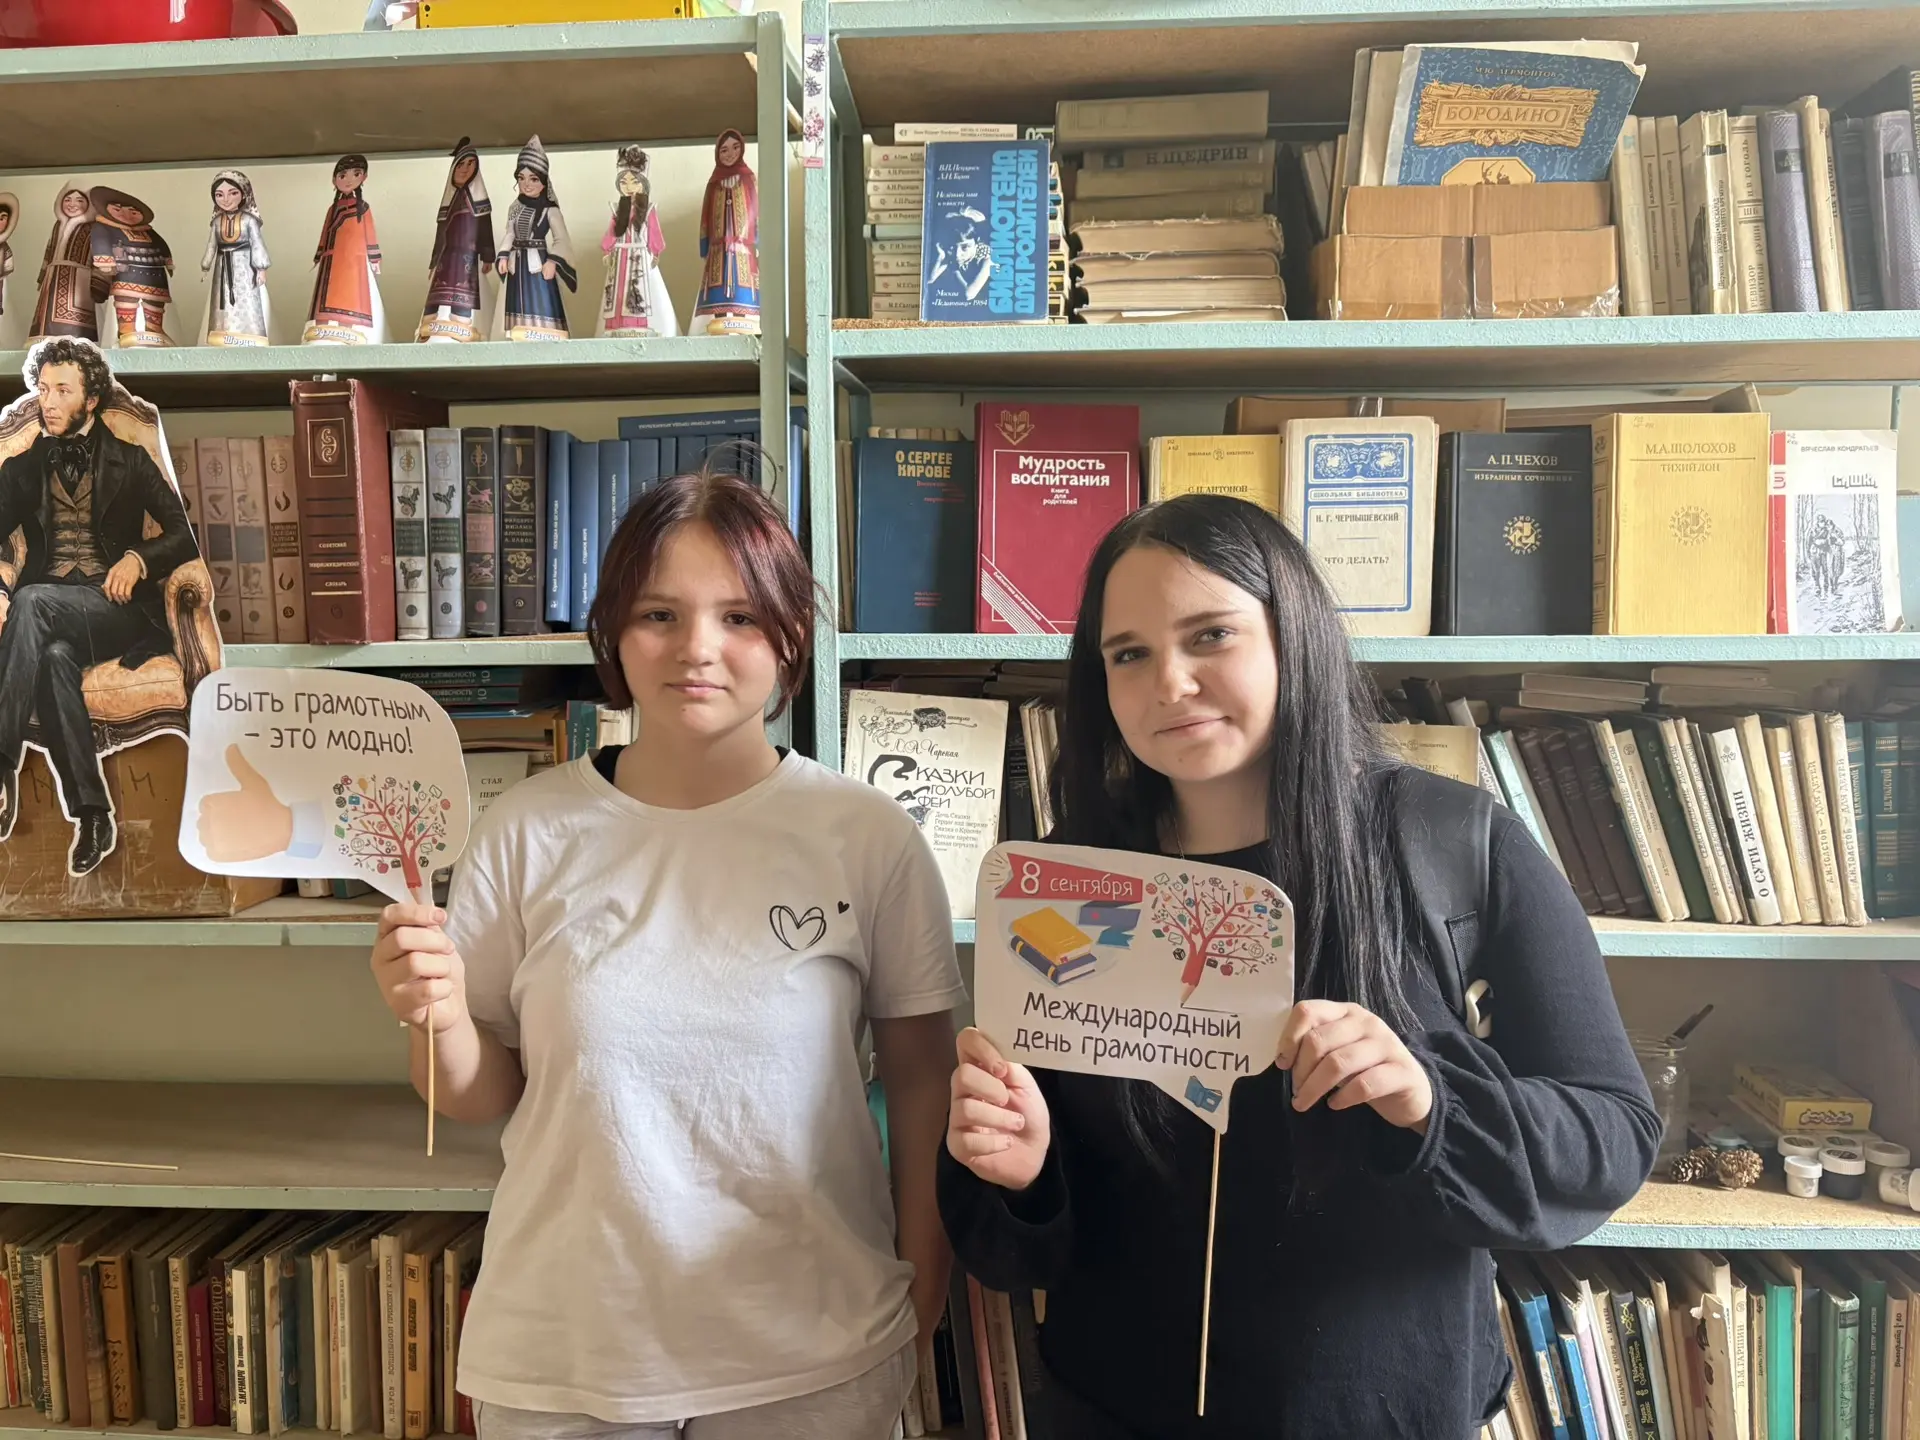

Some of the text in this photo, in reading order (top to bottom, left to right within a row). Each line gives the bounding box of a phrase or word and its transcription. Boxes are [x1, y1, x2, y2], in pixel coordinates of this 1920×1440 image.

[1500, 68, 1558, 78] ЛЕРМОНТОВ
[1445, 105, 1561, 123] БОРОДИНО
[1741, 138, 1753, 178] ГОГОЛЬ
[989, 150, 1018, 314] БИБЛИОТЕКА
[1014, 148, 1039, 314] ДЛЯ РОДИТЕЛЕЙ
[1753, 225, 1765, 256] ДУШИ
[1747, 264, 1758, 308] РЕВИЗОР
[723, 320, 754, 329] Ханты
[895, 451, 952, 465] О СЕРГЕЕ
[898, 464, 951, 478] КИРОВЕ
[1018, 455, 1106, 473] Мудрость
[1514, 455, 1558, 466] ЧЕХОВ
[1660, 462, 1720, 473] ТИХИЙ ДОН
[1011, 473, 1110, 487] воспитания
[1206, 485, 1248, 493] АНТОНОВ
[1474, 473, 1573, 482] ИЗБРАННЫЕ СОЧИНЕНИЯ
[1043, 497, 1078, 506] родителей
[1313, 489, 1404, 498] ШКОЛЬНАЯ БИБЛИОТЕКА
[1335, 511, 1399, 522] ЧЕРНЫШЕВСКИЙ
[318, 541, 347, 549] СОВЕТСКИЙ
[1323, 556, 1389, 566] ЧТО ДЕЛАТЬ?
[216, 683, 431, 723] Быть грамотным
[270, 727, 317, 749] это
[326, 727, 414, 755] модно!
[921, 739, 960, 760] Чарская
[868, 754, 985, 801] СКАЗКИ
[1609, 745, 1627, 784] РАССКАЗЫ
[1669, 745, 1686, 785] РАССКАЗЫ
[1808, 760, 1821, 794] ДЕТЕЙ
[1836, 758, 1849, 794] ДЕТЕЙ
[918, 796, 950, 809] ФЕИ
[930, 785, 995, 800] ГОЛУБОЙ
[1733, 790, 1770, 898] О СУТИ ЖИЗНИ
[1020, 860, 1133, 897] 8 сентября
[1023, 991, 1242, 1040] Международный
[1013, 1027, 1250, 1074] день грамотности
[212, 1276, 226, 1355] ИМПЕРАТОР
[386, 1326, 394, 1376] ВОЛШЕБНИКИ
[1610, 1344, 1618, 1366] МОРЯ
[1735, 1323, 1746, 1388] В.М.ГАРШИН
[238, 1370, 247, 1405] Э.М.РЕМАРК
[1616, 1373, 1627, 1406] МАЛЬЧИК
[387, 1386, 396, 1423] А.ШАРОВ
